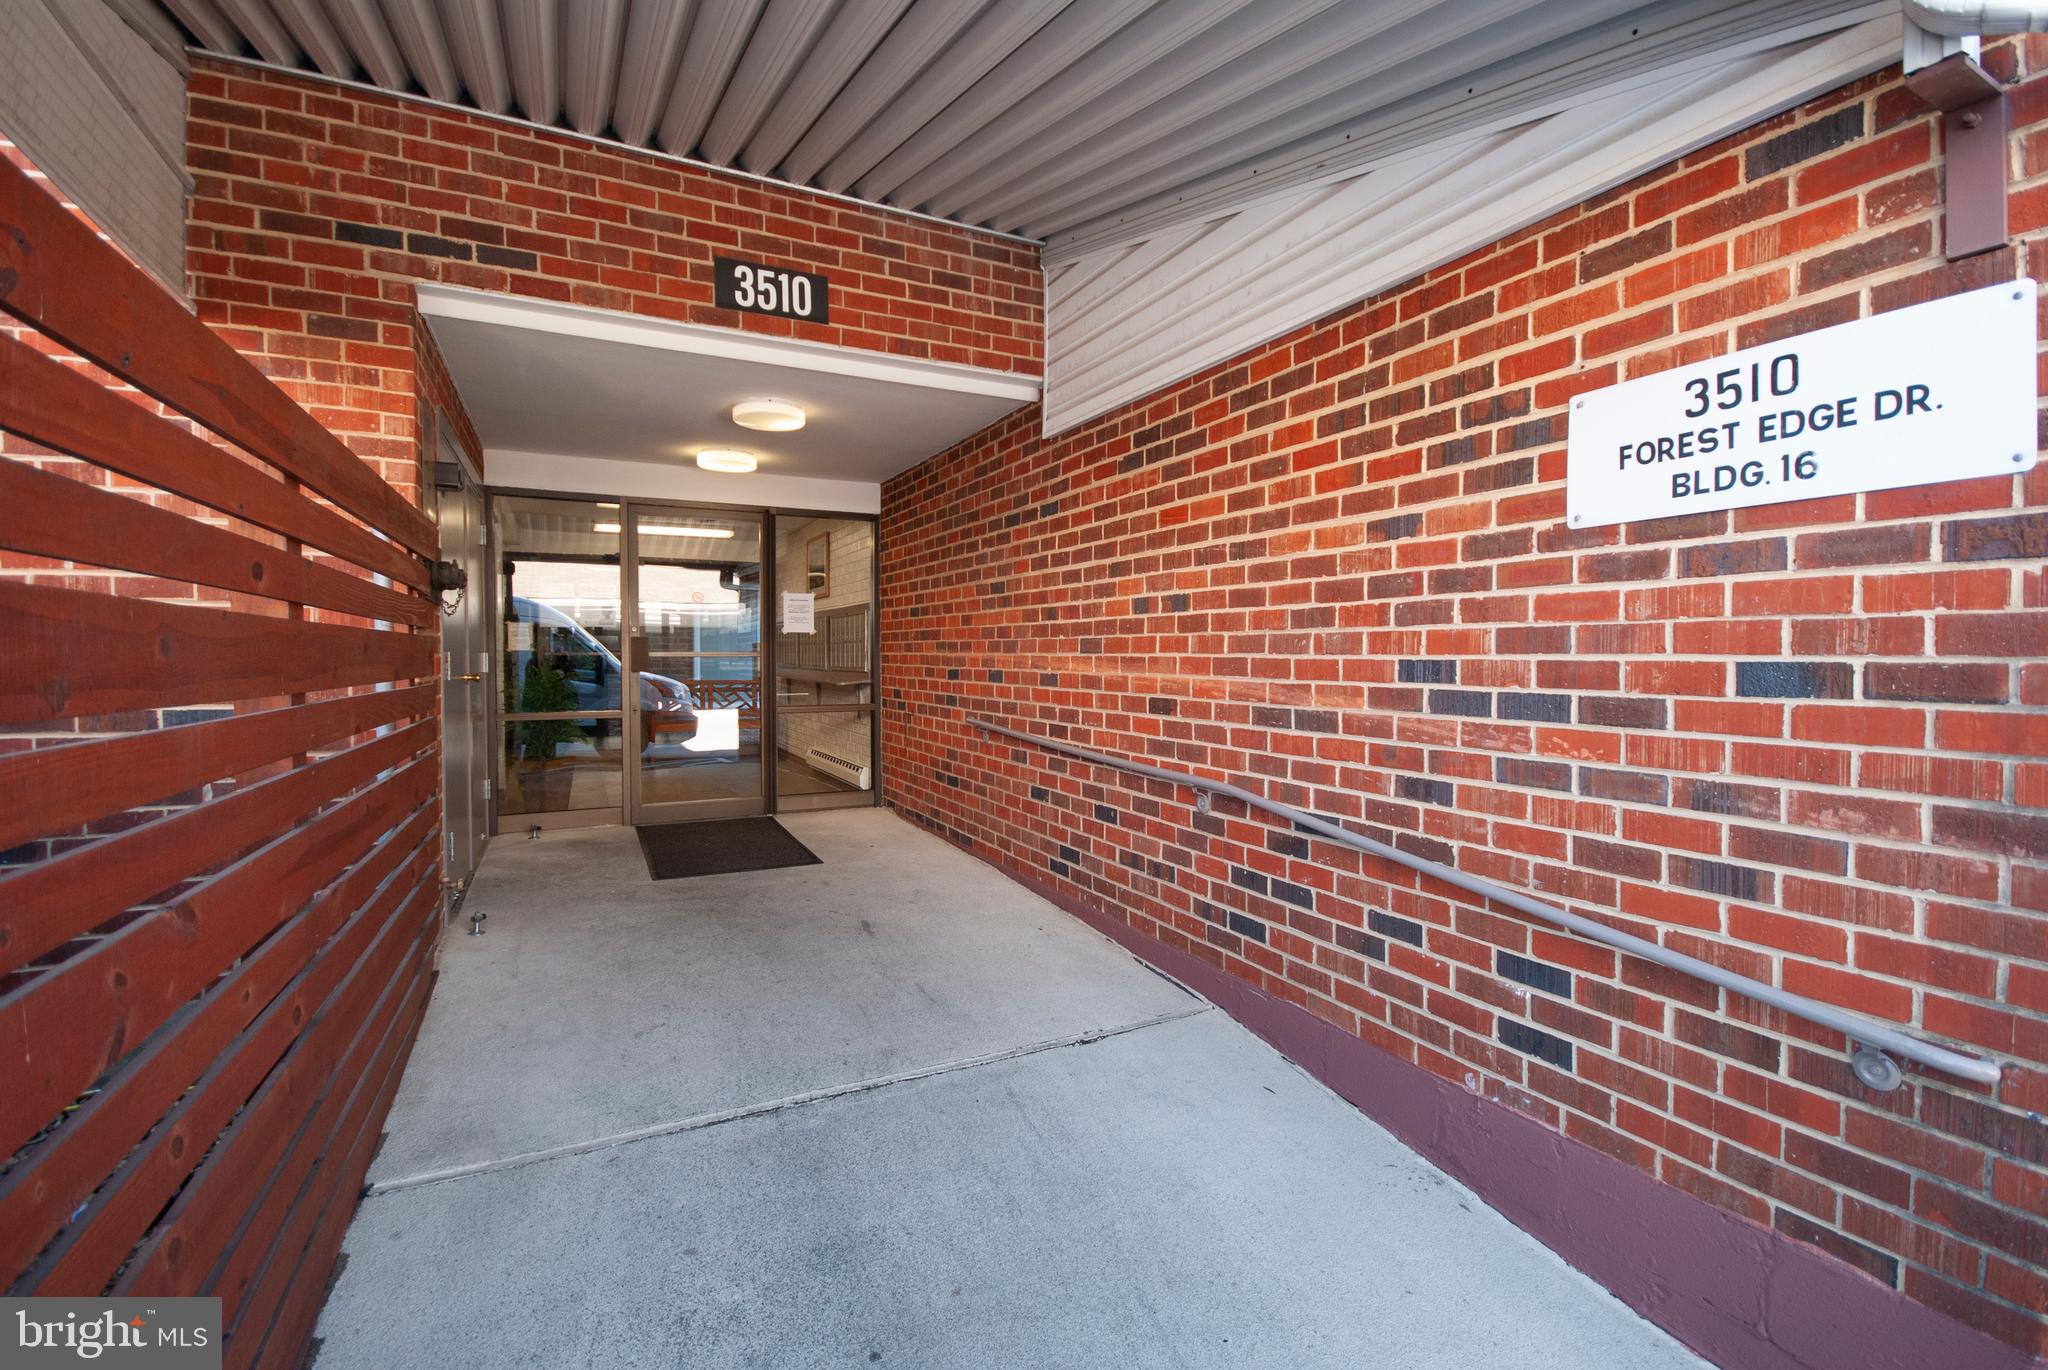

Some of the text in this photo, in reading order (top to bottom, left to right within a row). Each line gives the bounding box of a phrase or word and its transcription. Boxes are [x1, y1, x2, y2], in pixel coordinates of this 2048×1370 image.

[734, 265, 812, 316] 3510
[1684, 353, 1800, 418] 3510
[1618, 383, 1944, 470] FOREST EDGE DR.
[1671, 450, 1819, 499] BLDG. 16
